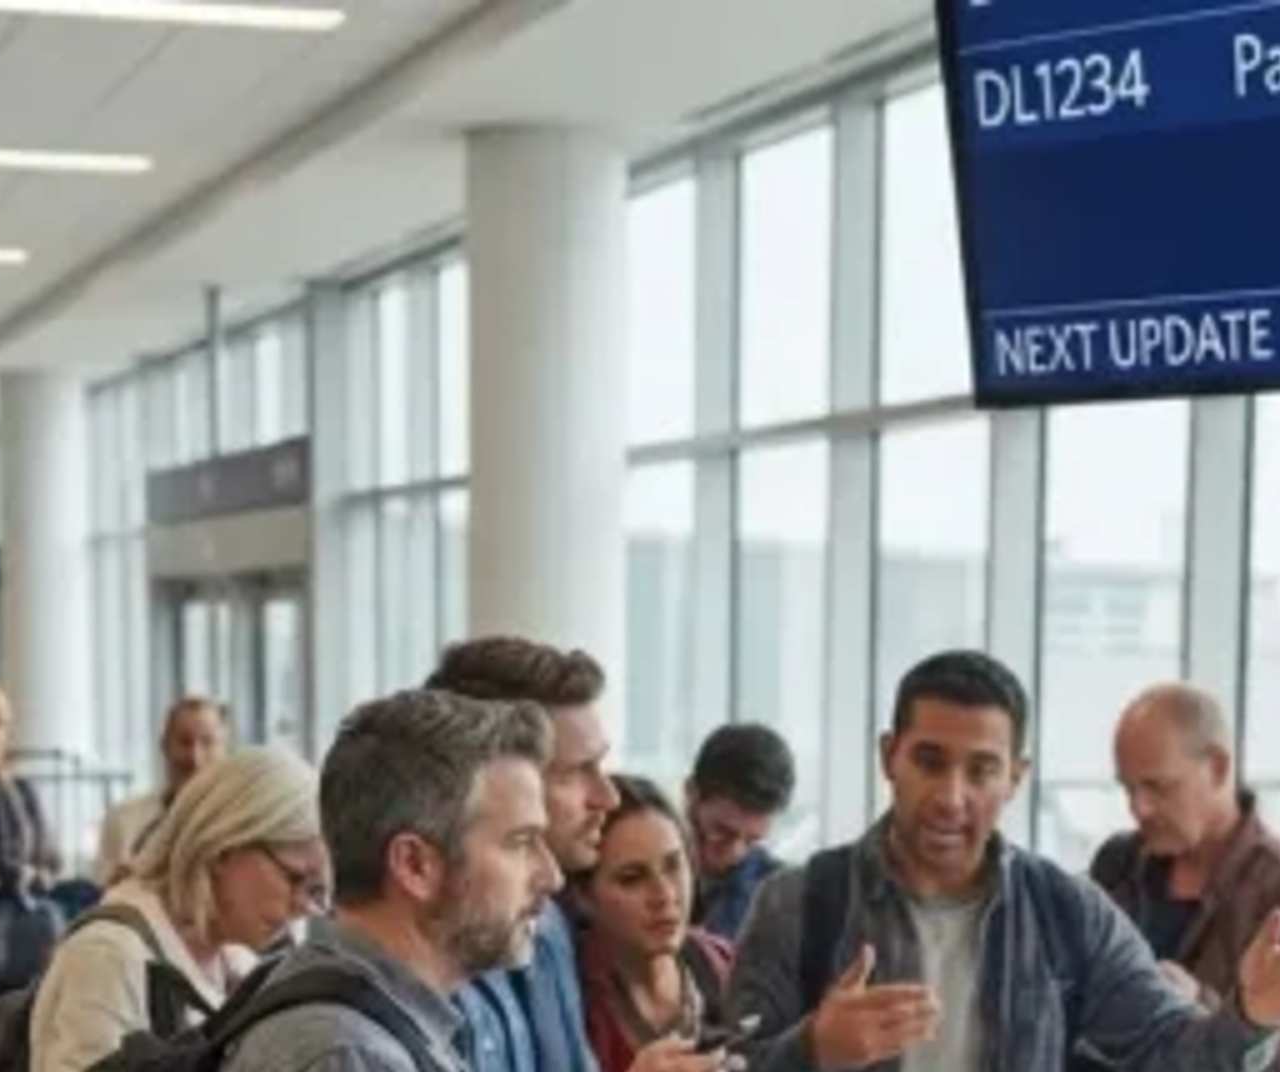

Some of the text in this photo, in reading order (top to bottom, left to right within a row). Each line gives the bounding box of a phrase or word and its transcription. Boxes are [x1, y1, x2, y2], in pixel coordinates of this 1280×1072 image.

[975, 48, 1150, 127] DL1234
[994, 323, 1100, 376] NEXT
[1108, 308, 1275, 368] UPDATE
